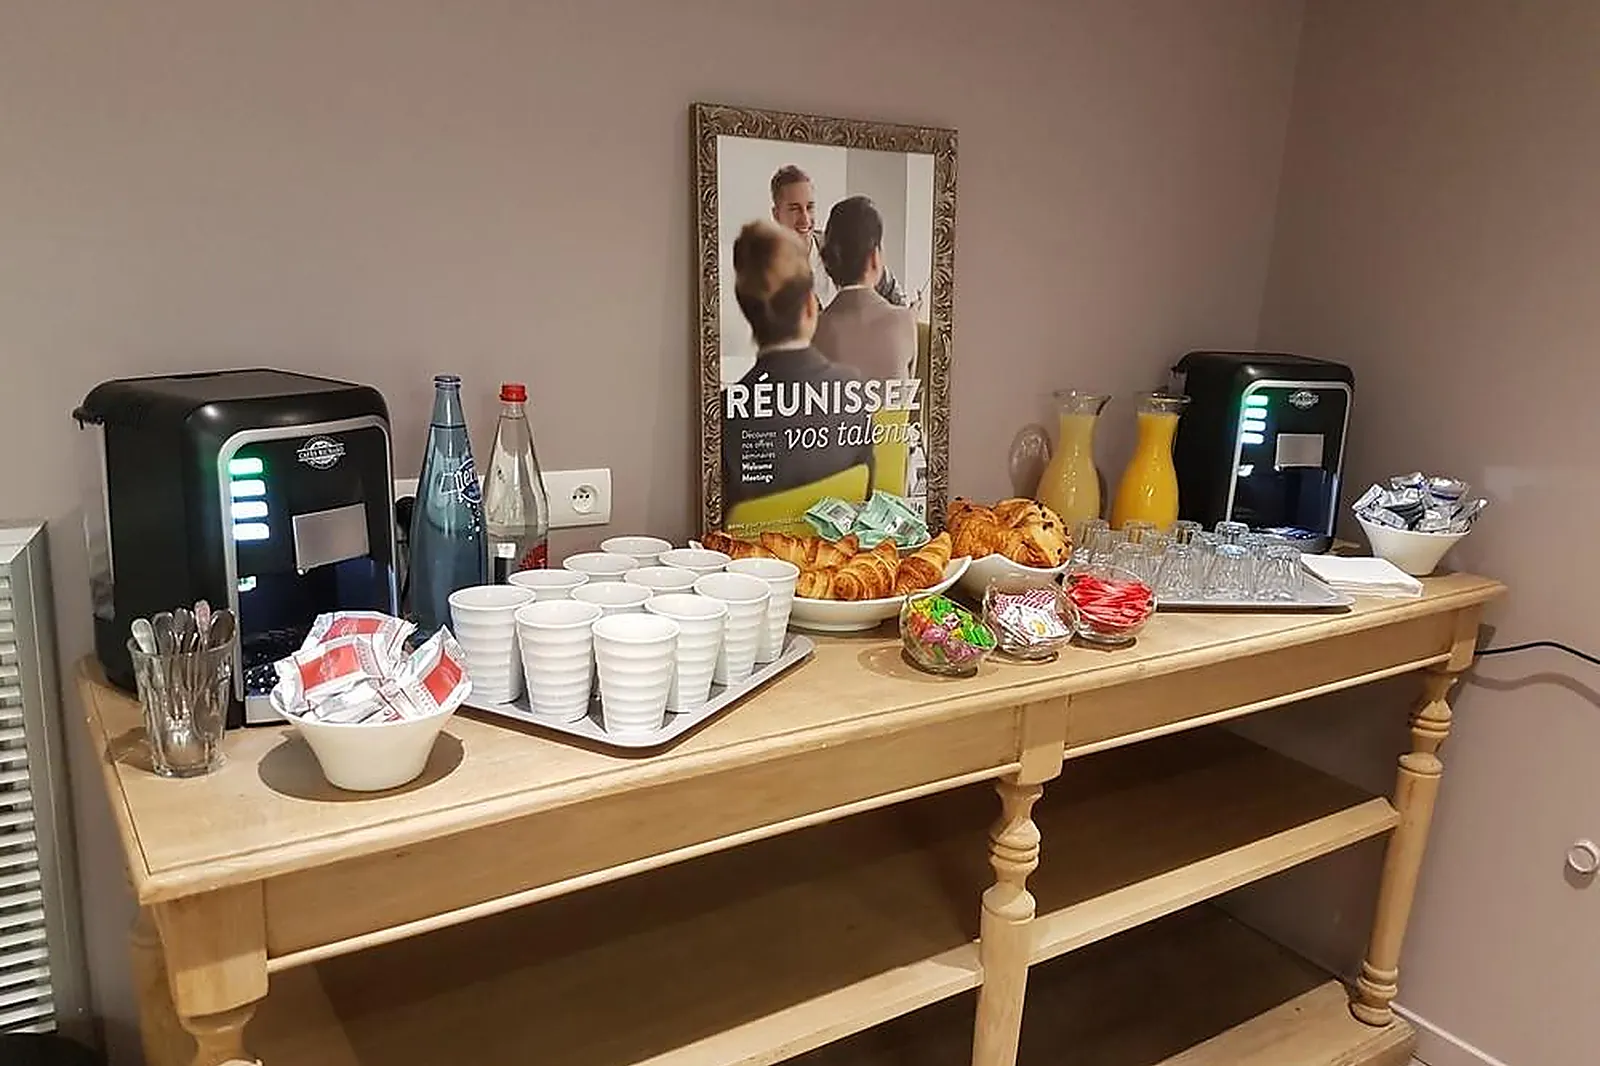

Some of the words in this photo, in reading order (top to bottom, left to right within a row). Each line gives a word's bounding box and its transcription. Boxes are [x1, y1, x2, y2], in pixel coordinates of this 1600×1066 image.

[726, 372, 922, 419] RÉUNISSEZ
[784, 427, 830, 450] vos
[837, 414, 922, 447] talents
